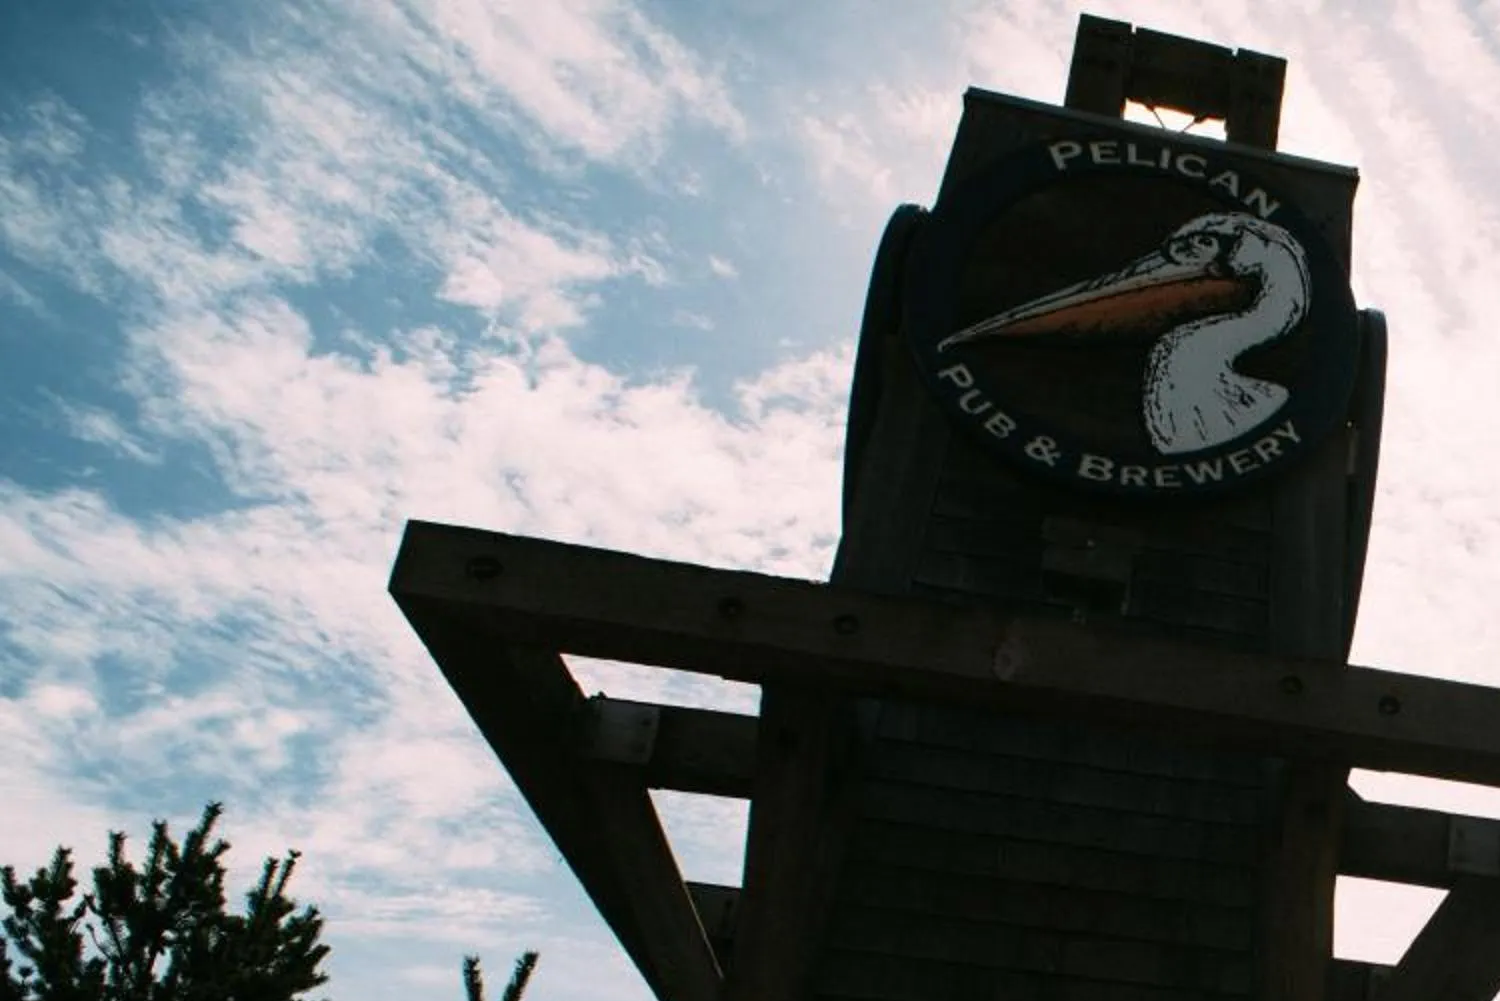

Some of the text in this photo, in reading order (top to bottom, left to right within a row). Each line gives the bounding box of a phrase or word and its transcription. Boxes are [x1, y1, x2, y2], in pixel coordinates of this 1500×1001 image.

[1048, 140, 1281, 219] PELICAN
[938, 363, 1302, 488] PUB & BREWERY
